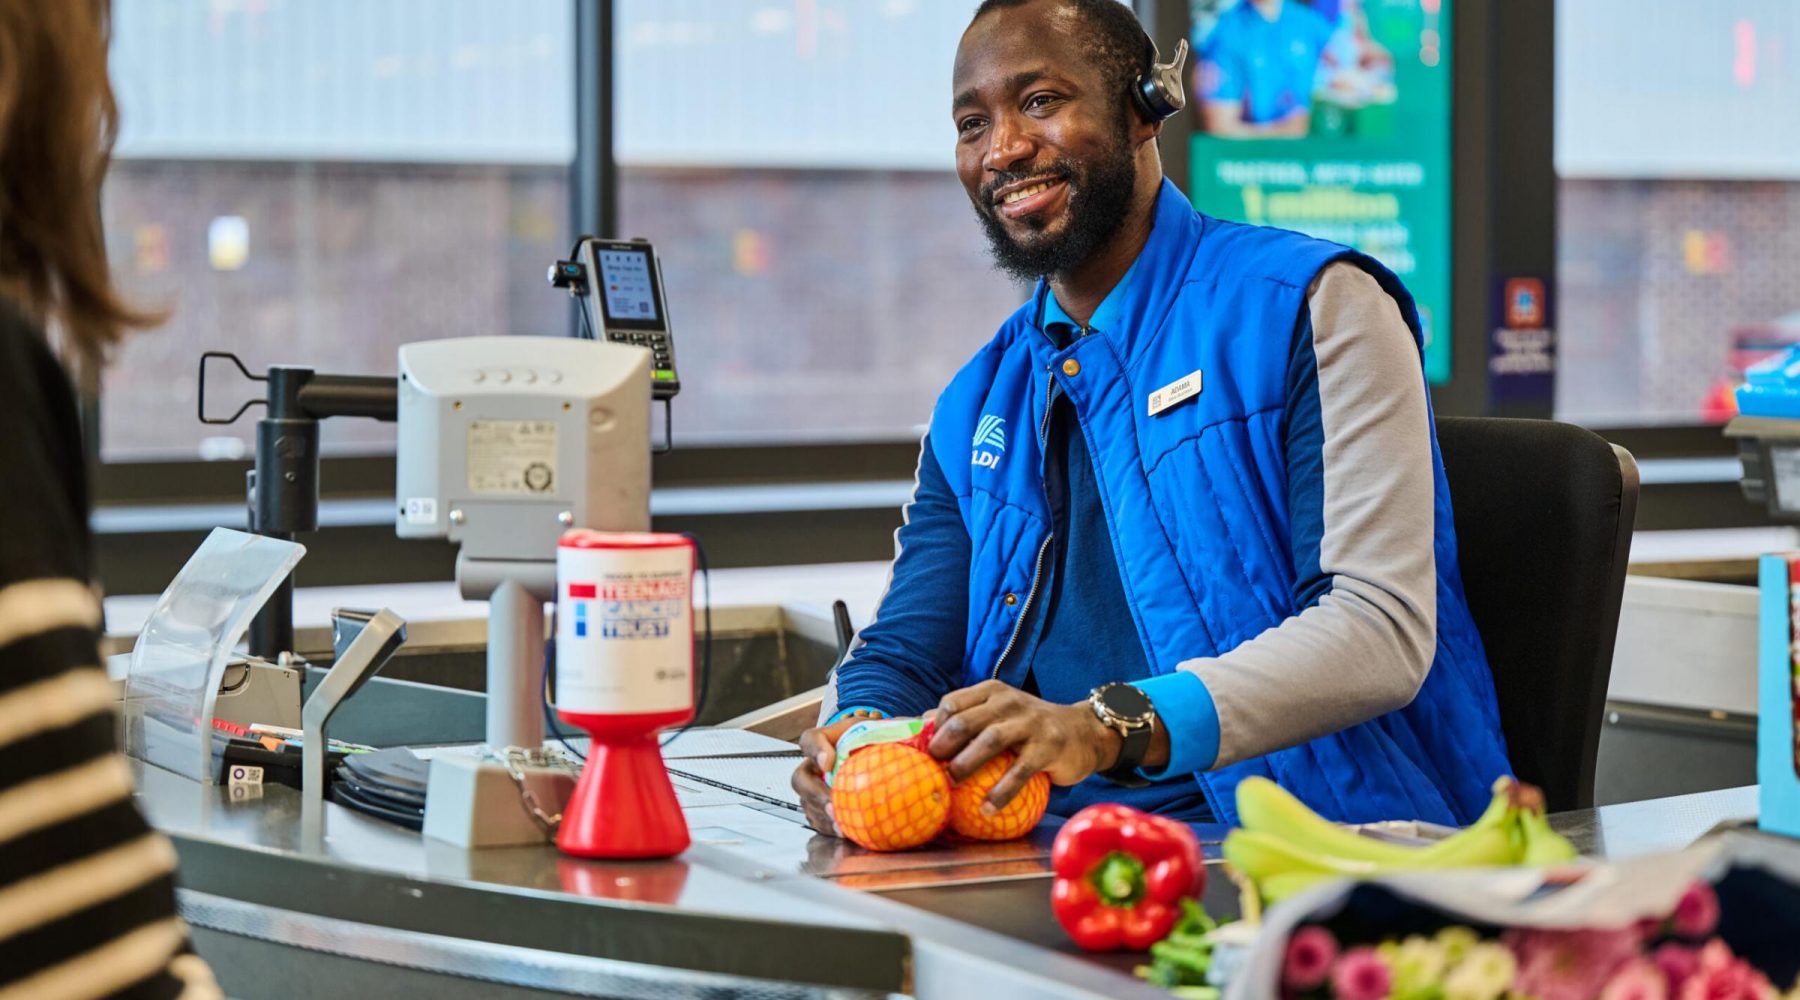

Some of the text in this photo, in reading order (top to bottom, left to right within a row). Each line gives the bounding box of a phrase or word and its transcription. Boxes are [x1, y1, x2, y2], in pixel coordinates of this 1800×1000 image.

[971, 450, 1000, 469] LDI
[602, 579, 687, 601] TEENAGE
[602, 619, 669, 638] TRUST
